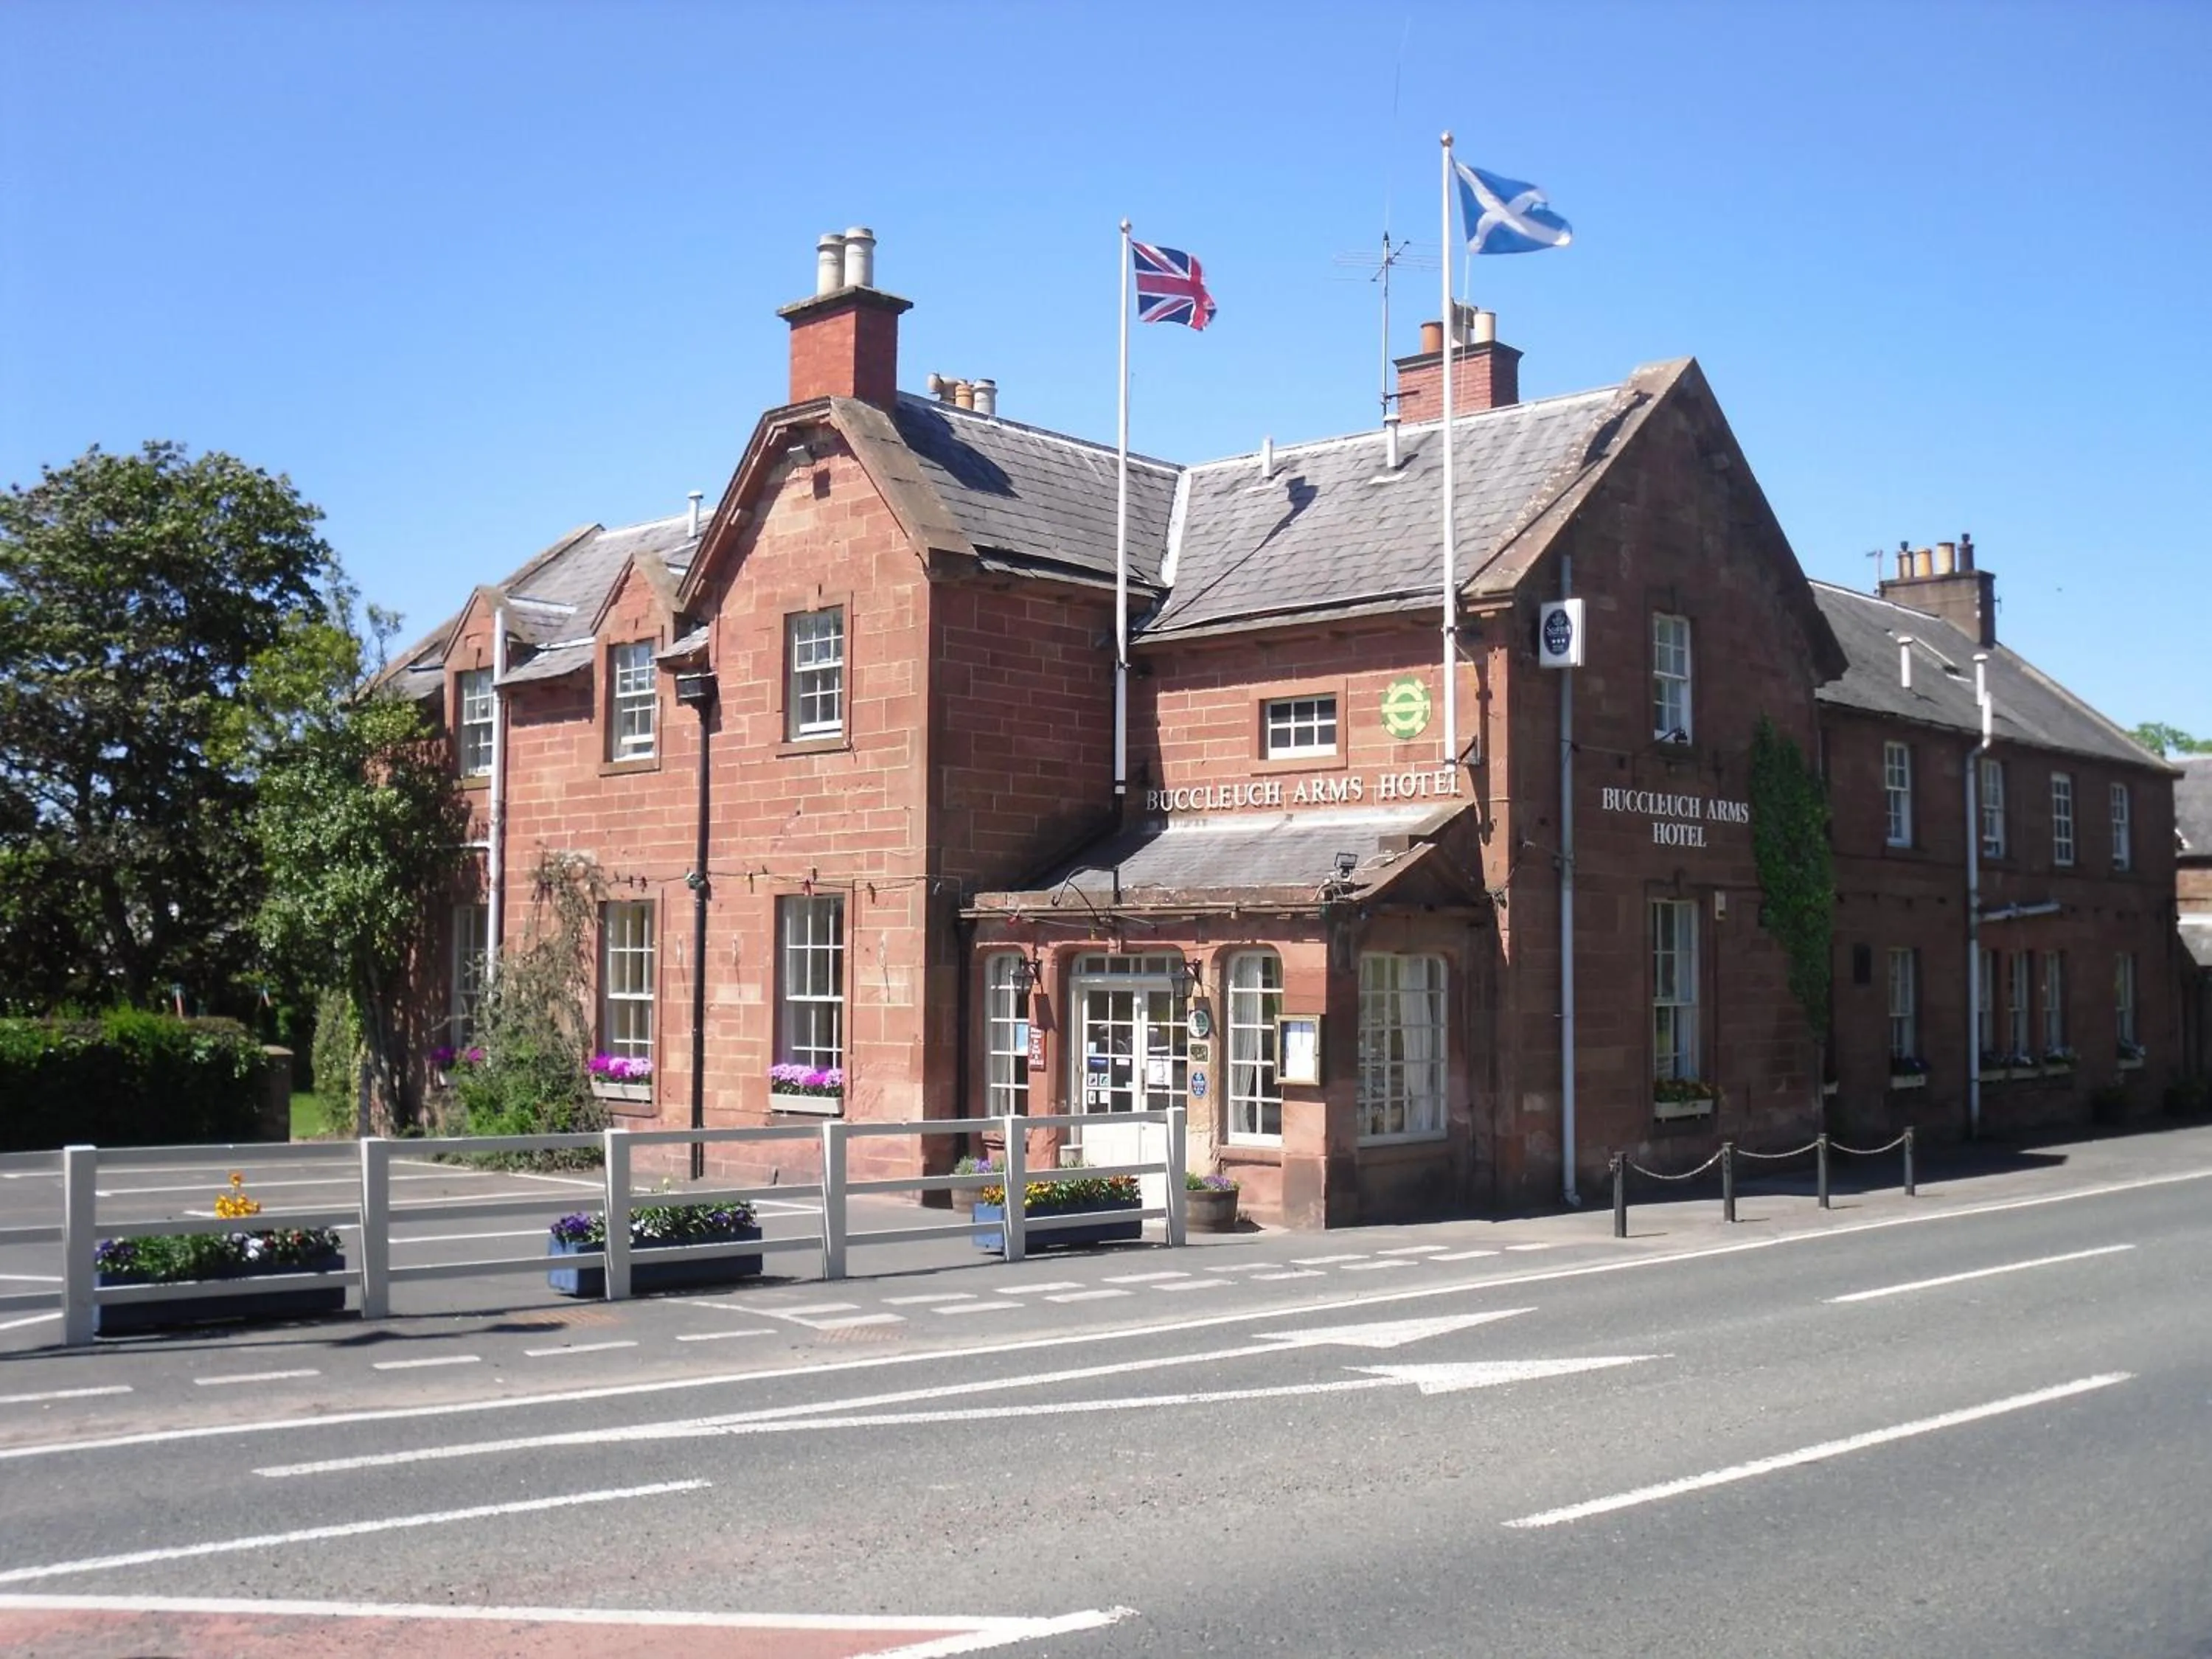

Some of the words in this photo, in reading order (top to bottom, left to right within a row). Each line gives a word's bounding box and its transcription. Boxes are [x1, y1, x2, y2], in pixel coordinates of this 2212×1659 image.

[1146, 782, 1281, 811] BUCCLEUCH
[1293, 776, 1363, 803] ARMS
[1379, 770, 1461, 798] HOTEL
[1602, 787, 1701, 818] BUCCLEUCH
[1706, 799, 1749, 824] ARMS
[1652, 822, 1707, 847] HOTEL
